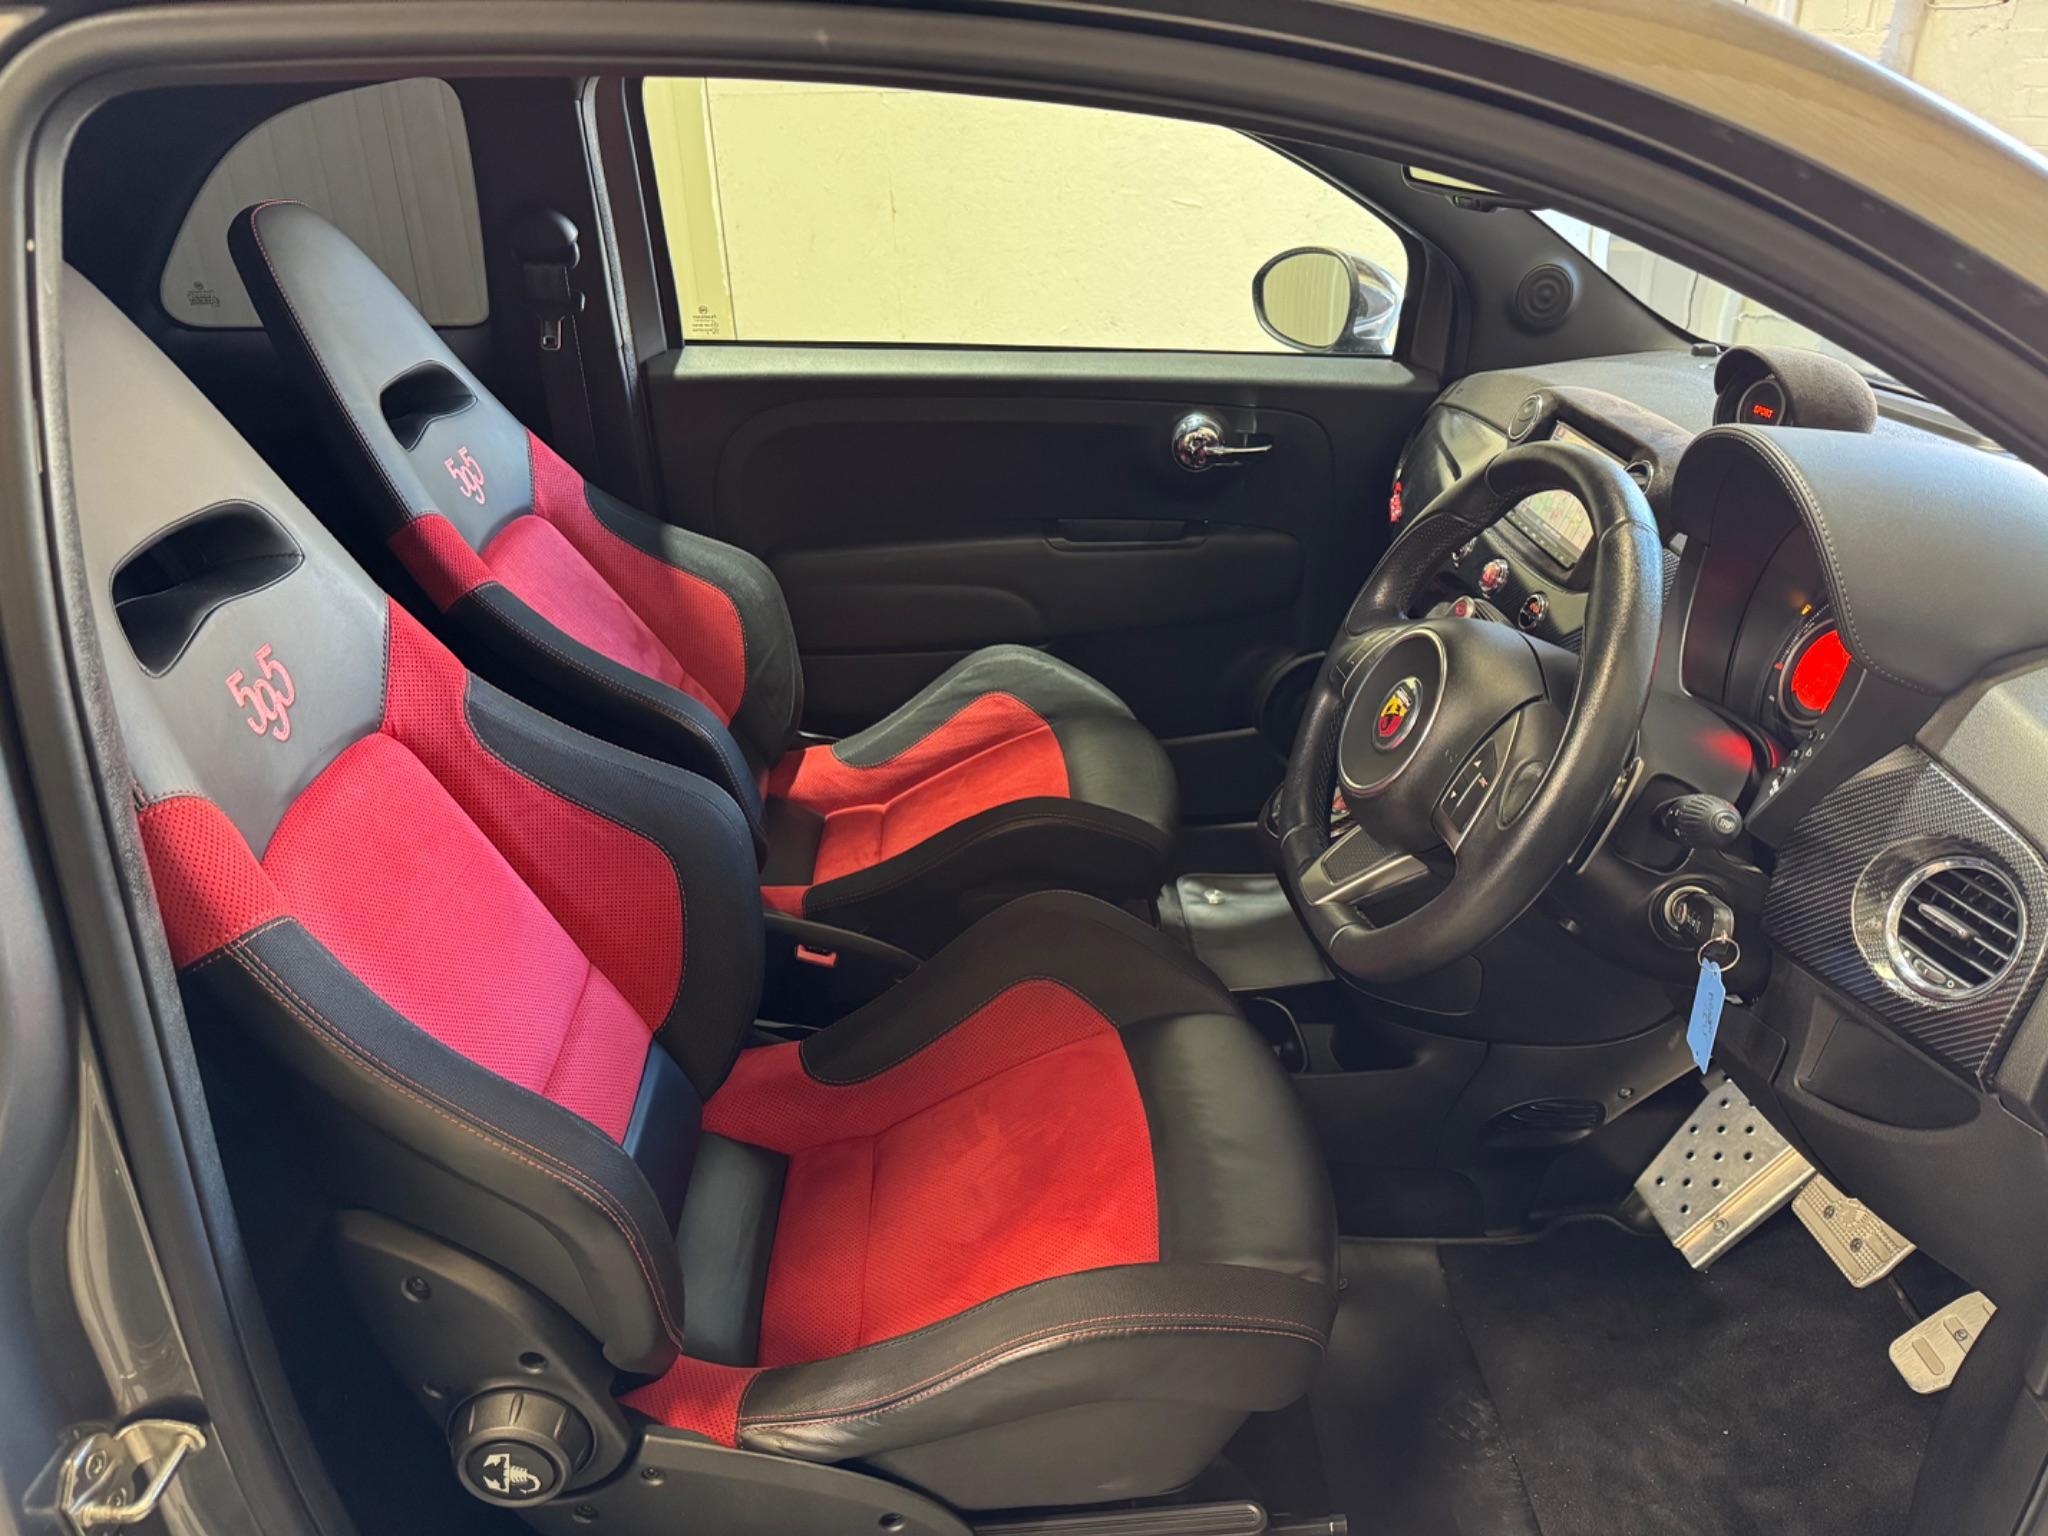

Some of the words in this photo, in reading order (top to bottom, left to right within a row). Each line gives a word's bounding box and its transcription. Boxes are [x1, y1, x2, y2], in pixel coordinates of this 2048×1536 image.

[1753, 404, 1774, 419] SPORT
[443, 446, 485, 505] 595
[225, 643, 295, 742] 595
